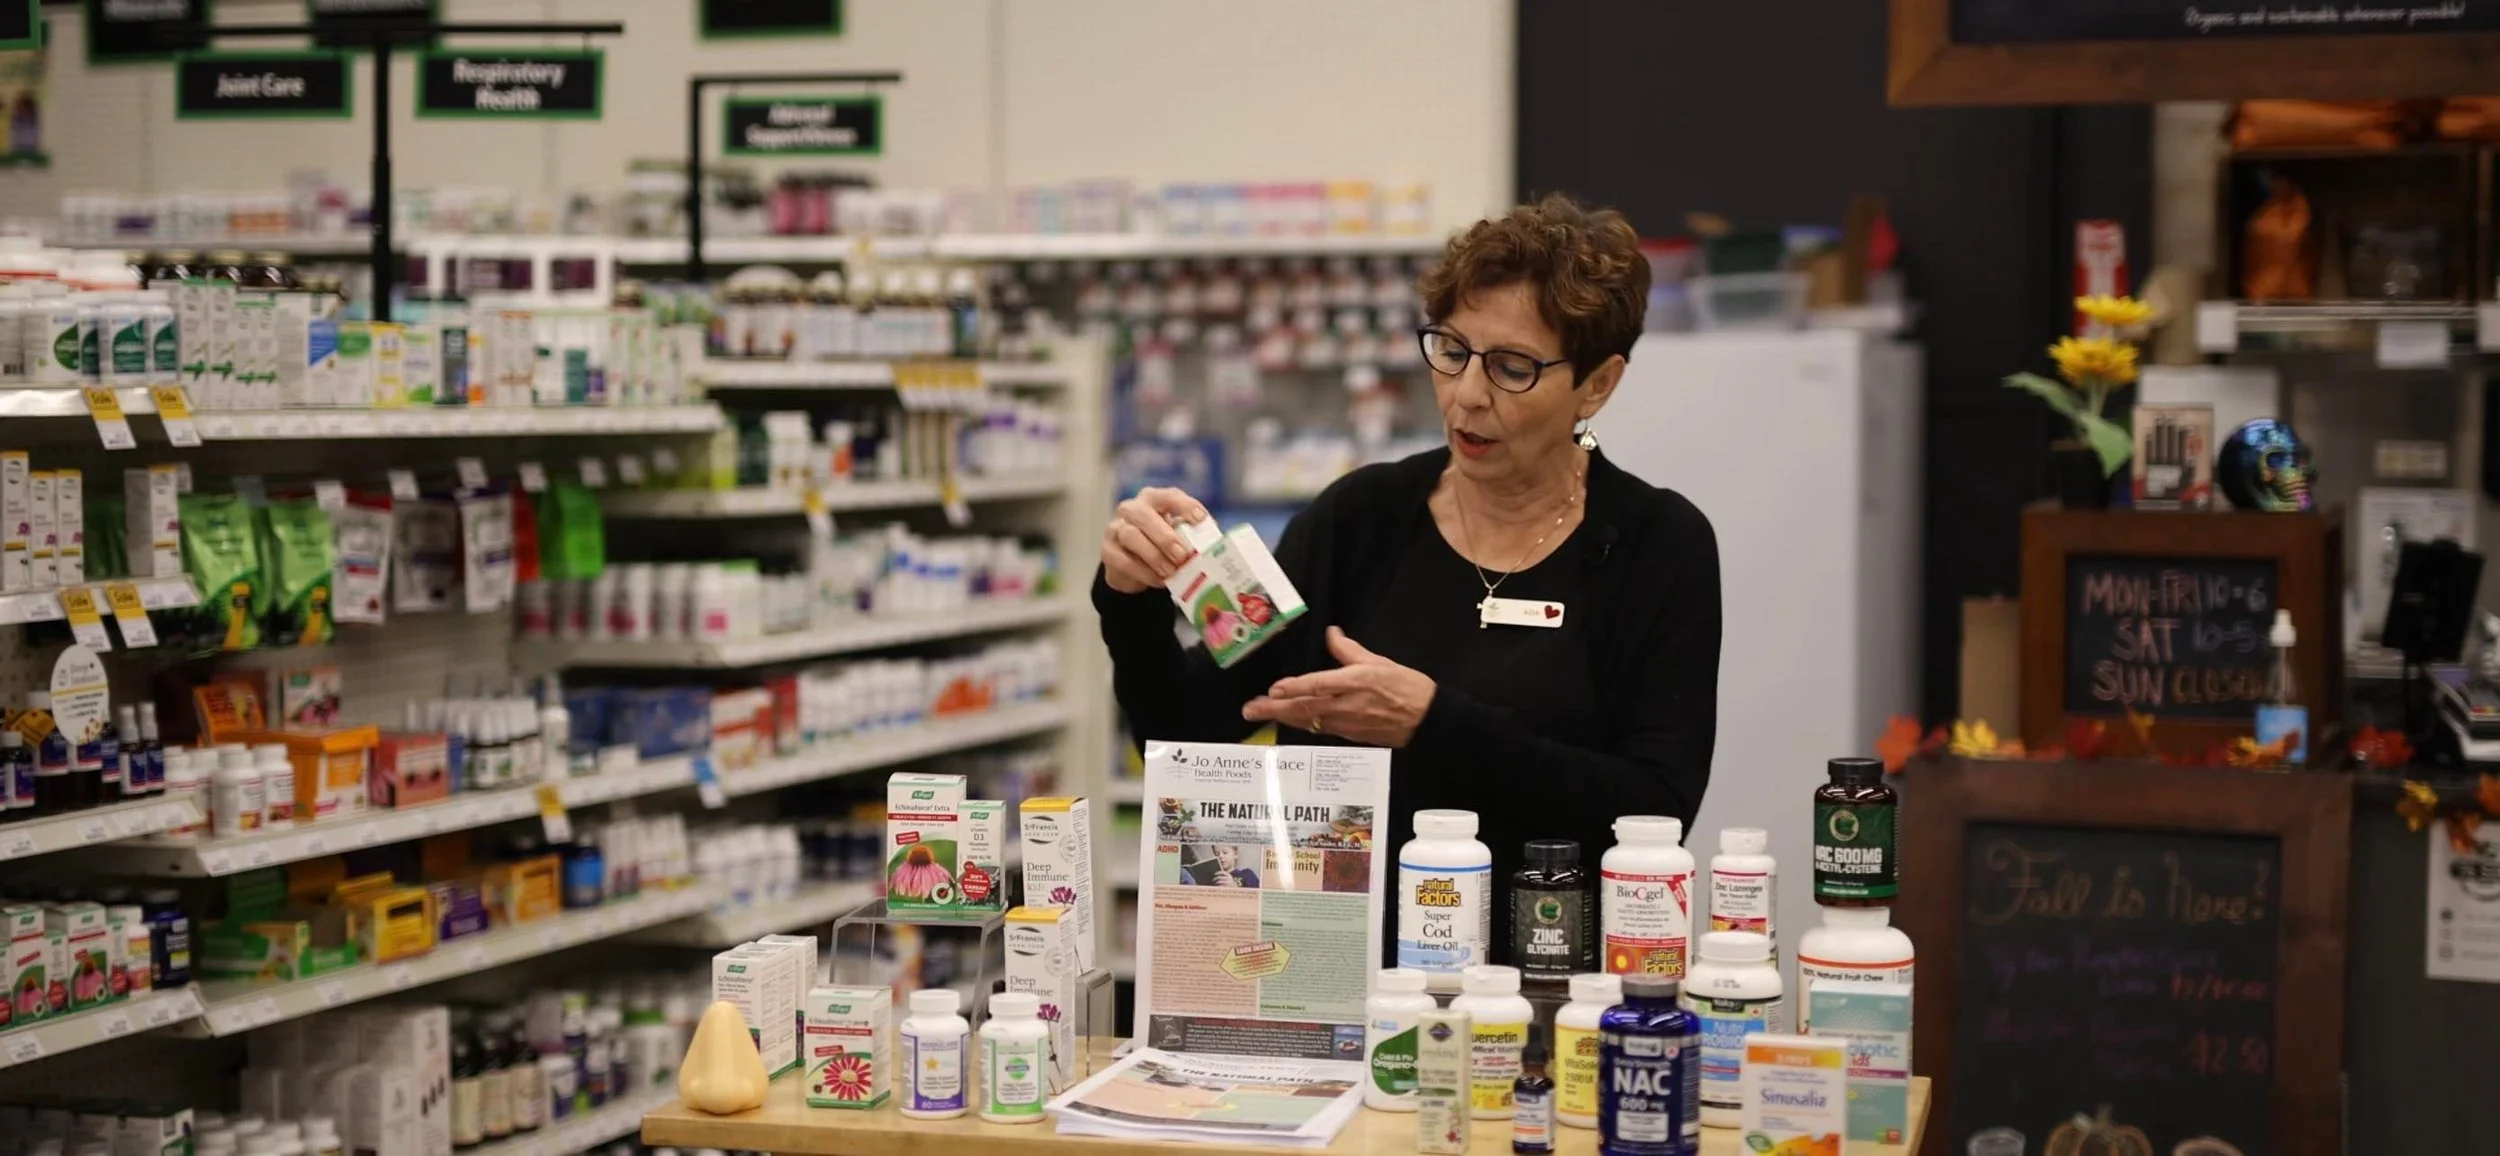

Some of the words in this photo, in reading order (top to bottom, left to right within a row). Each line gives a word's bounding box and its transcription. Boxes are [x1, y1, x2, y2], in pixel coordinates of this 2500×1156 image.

[2184, 6, 2236, 33] Organic
[453, 57, 567, 88] Respiratory
[215, 73, 260, 98] Joint
[261, 72, 306, 97] Care
[474, 85, 542, 111] Health
[2110, 616, 2182, 663] SAT
[2090, 659, 2166, 706] SUN
[1192, 756, 1209, 767] Jo
[1213, 756, 1263, 769] Anne's
[1194, 769, 1223, 778] Health
[1225, 769, 1252, 779] Foods
[1200, 802, 1226, 818] THE
[1228, 803, 1291, 821] NATURL
[1294, 805, 1331, 823] PATH
[1834, 847, 1861, 863] 600
[1026, 862, 1052, 874] Deep
[1027, 873, 1069, 882] Immune
[1424, 878, 1455, 891] natural
[1416, 885, 1461, 907] Factors
[1424, 909, 1452, 923] Super
[1422, 923, 1452, 938] Cod
[1532, 928, 1564, 944] ZINC
[1417, 940, 1440, 951] Liver
[1443, 941, 1458, 951] Oil
[1009, 975, 1036, 988] Deep
[1817, 971, 1842, 979] Natural
[1844, 973, 1862, 981] Fruit
[1471, 1033, 1518, 1044] uercetin
[1614, 1066, 1671, 1096] NAC
[1620, 1096, 1648, 1111] 600
[1761, 1089, 1826, 1109] Sinusalia
